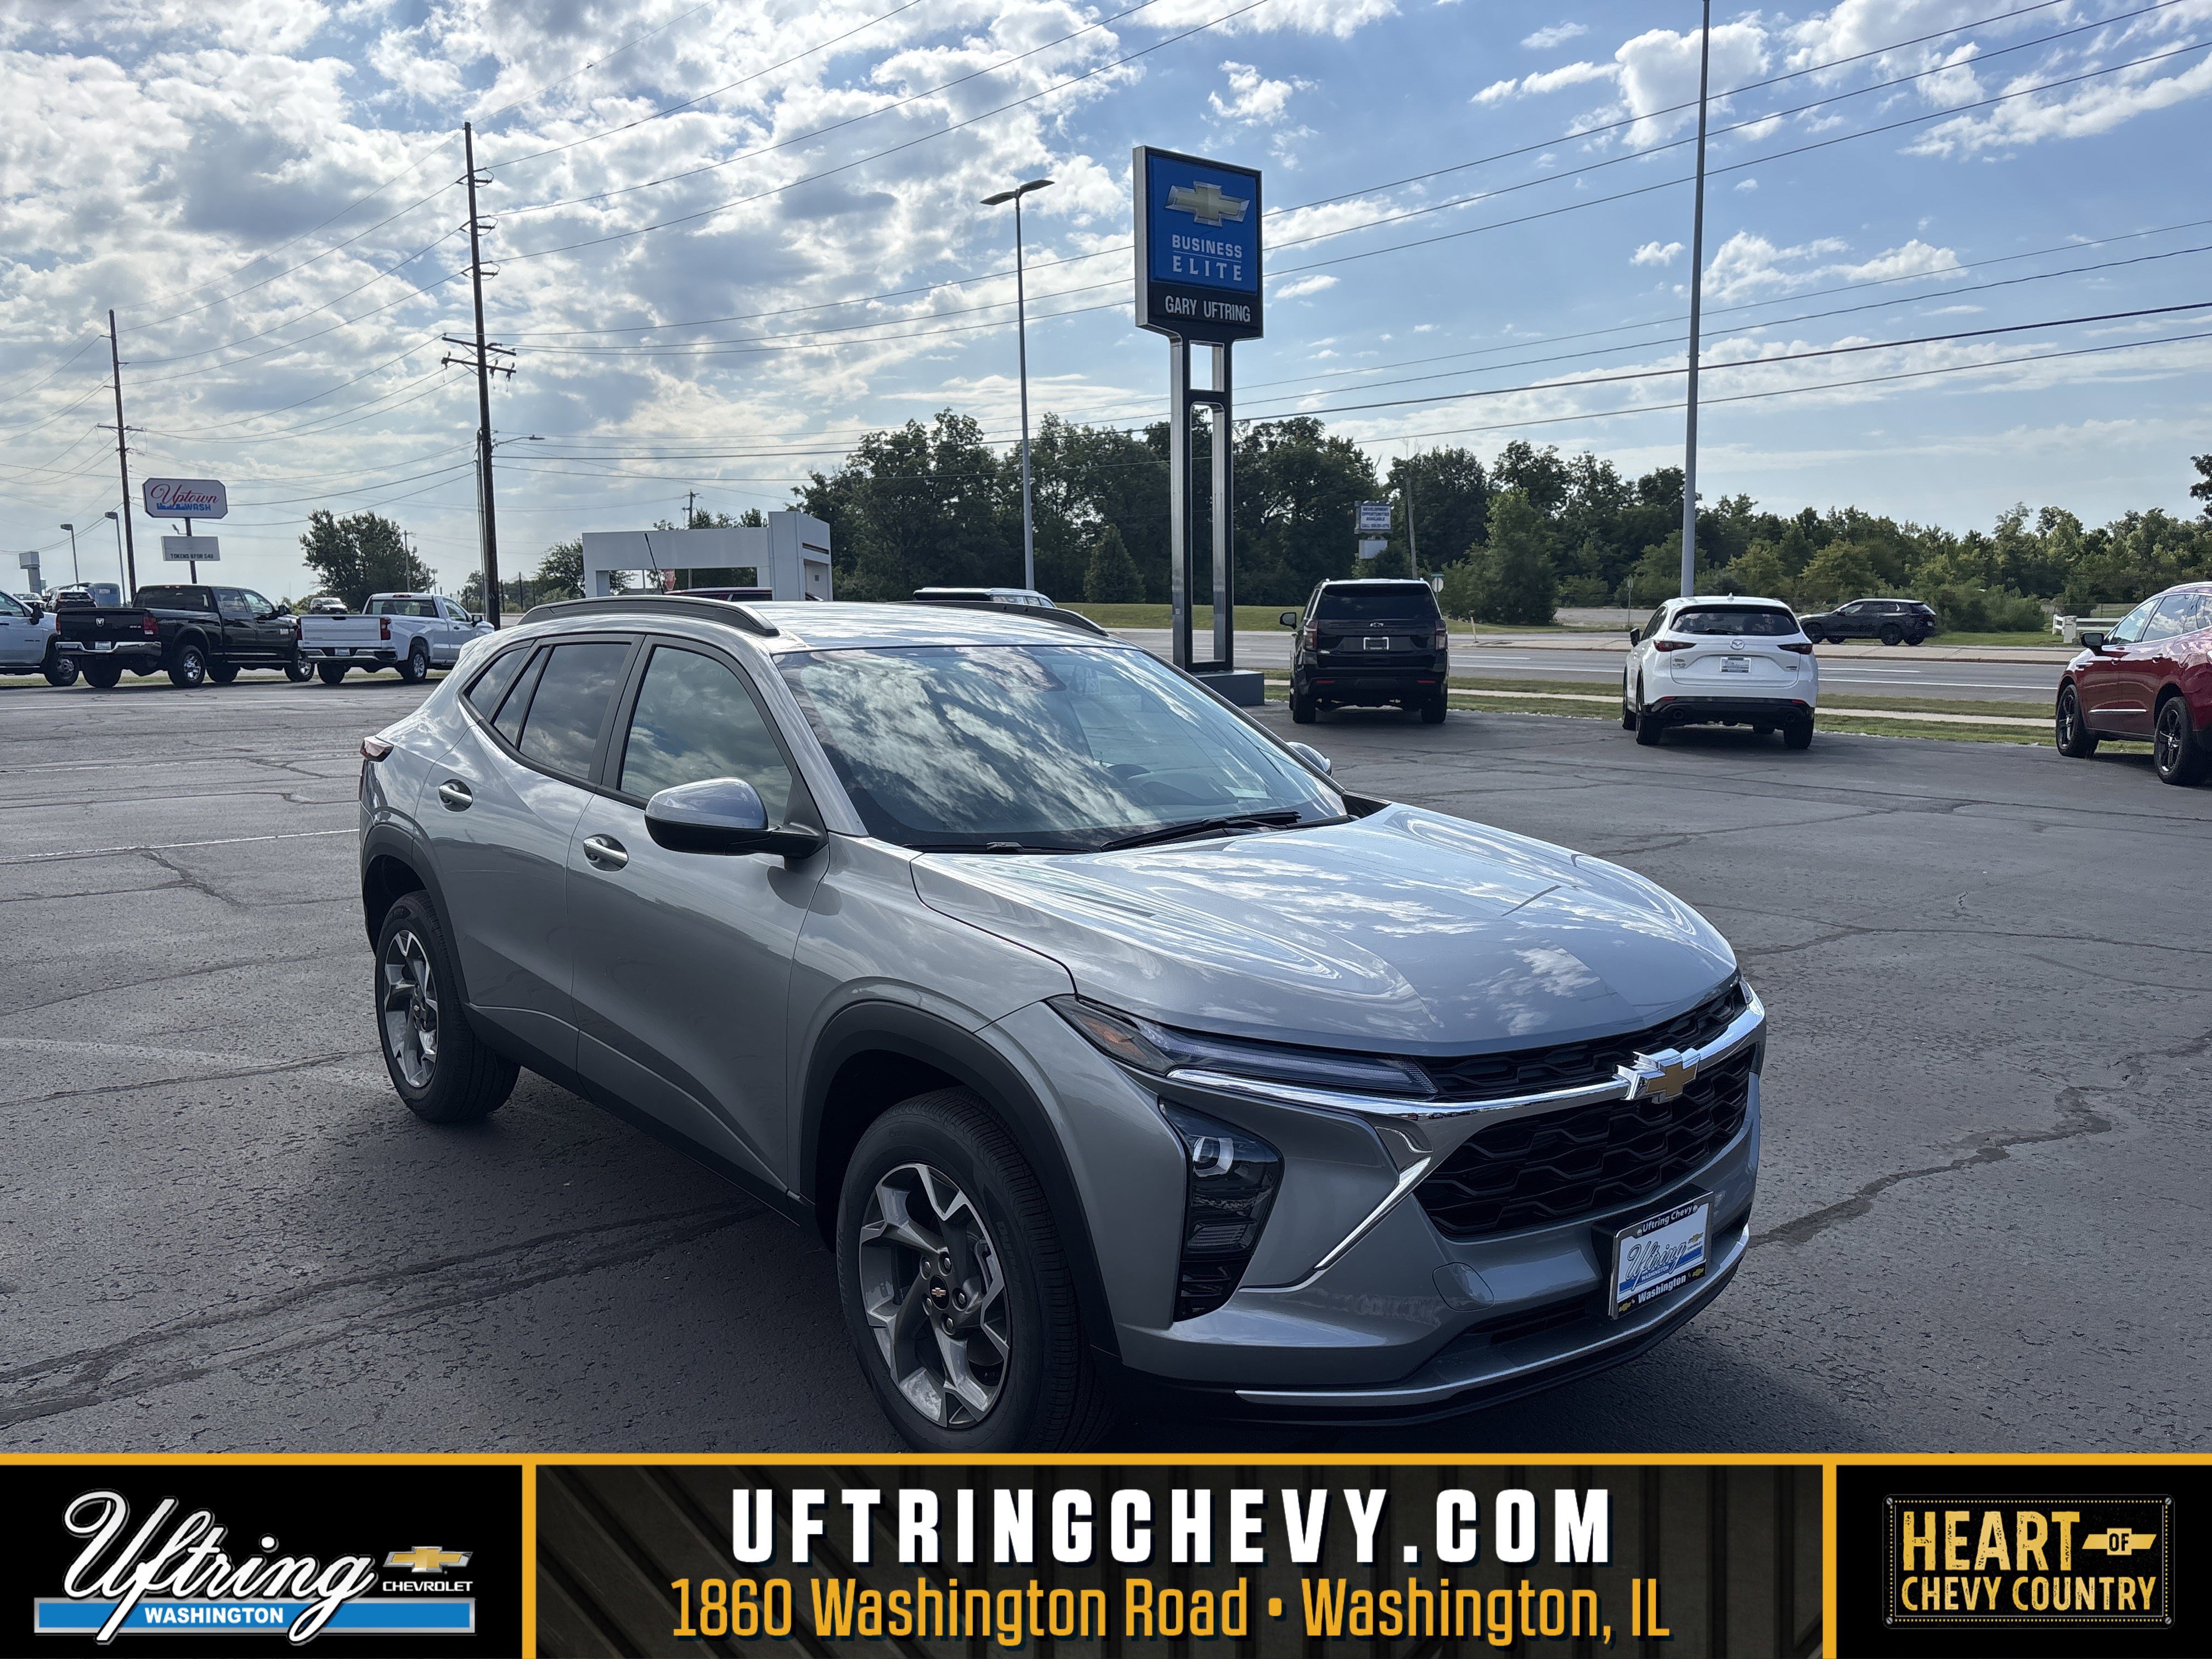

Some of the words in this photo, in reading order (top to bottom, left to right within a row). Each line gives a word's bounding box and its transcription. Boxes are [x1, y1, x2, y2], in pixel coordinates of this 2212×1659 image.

[1172, 234, 1243, 258] BUSINESS
[1172, 256, 1243, 281] ELITE
[1165, 295, 1198, 315] GARY
[1203, 300, 1251, 323] UFTRING
[150, 483, 219, 506] Uptown
[185, 503, 211, 511] WASH
[1643, 1215, 1669, 1233] Uftring
[1671, 1205, 1693, 1221] Chevy
[1626, 1241, 1687, 1291] Uftring
[1641, 1265, 1669, 1281] WASHINGTON
[1638, 1274, 1686, 1304] Washington
